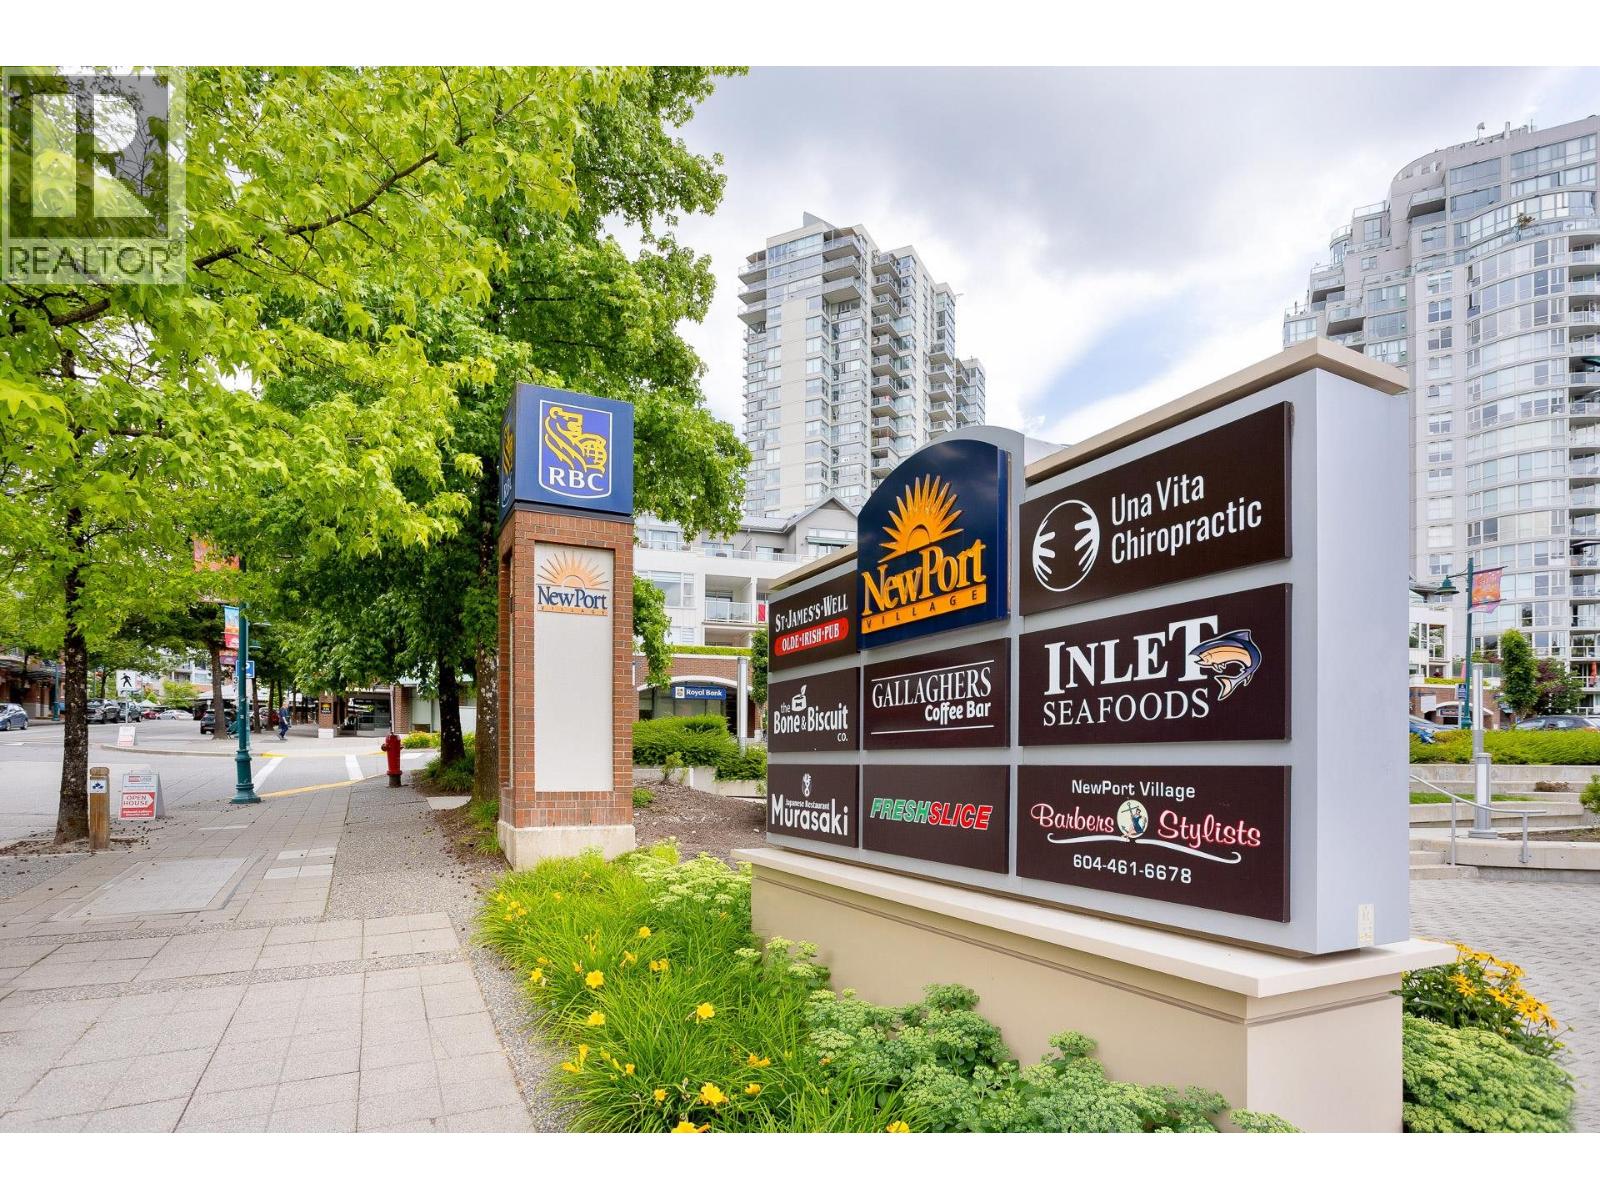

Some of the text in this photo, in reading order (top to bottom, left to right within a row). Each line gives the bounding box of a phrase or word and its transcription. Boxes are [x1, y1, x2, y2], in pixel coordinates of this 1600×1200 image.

[548, 466, 605, 491] RBC
[1111, 473, 1205, 526] Una Vita
[1111, 497, 1262, 565] Chiropractic
[861, 539, 987, 616] NewPort
[537, 585, 608, 610] NewPort
[865, 590, 978, 629] VILLAGE
[1043, 615, 1219, 696] INLET
[686, 688, 722, 697] Royal Bank
[872, 666, 992, 709] GALLAGHERS
[1043, 687, 1210, 727] SEAFOODS
[773, 710, 800, 735] Bone
[807, 702, 848, 732] Biscuit
[780, 701, 791, 714] the
[924, 700, 992, 725] Coffee Bar
[1071, 779, 1196, 802] NewPort Village
[771, 793, 848, 836] Murasaki
[1030, 803, 1262, 849] Barbers Stylists
[1072, 854, 1193, 884] 604-461-6678
